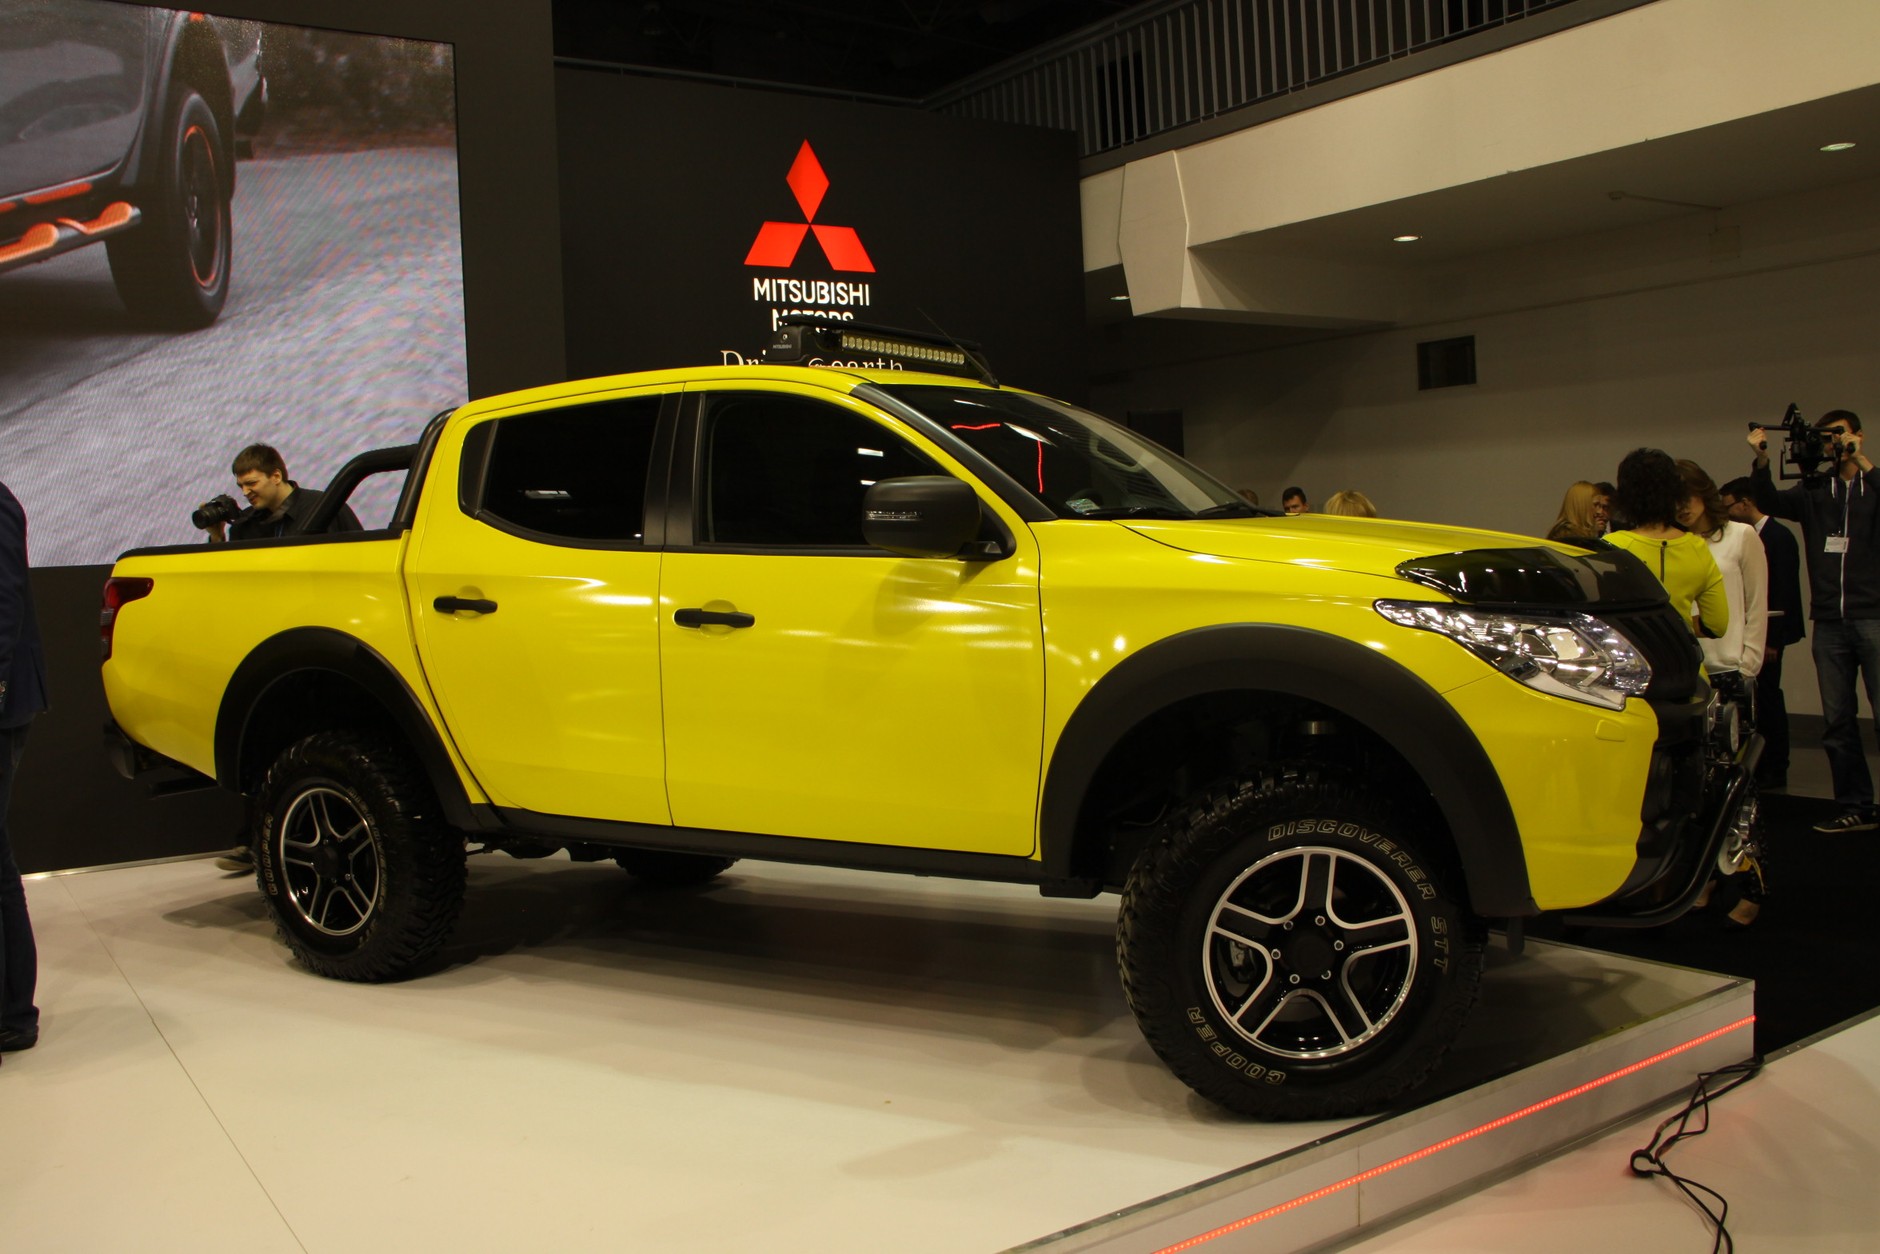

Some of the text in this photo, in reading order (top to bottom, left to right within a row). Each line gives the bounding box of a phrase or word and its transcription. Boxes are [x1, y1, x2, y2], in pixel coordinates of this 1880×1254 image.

[754, 278, 870, 306] MITSUBISHI
[1268, 819, 1448, 975] DISCOVERER STT
[1187, 1007, 1286, 1085] COOPER
